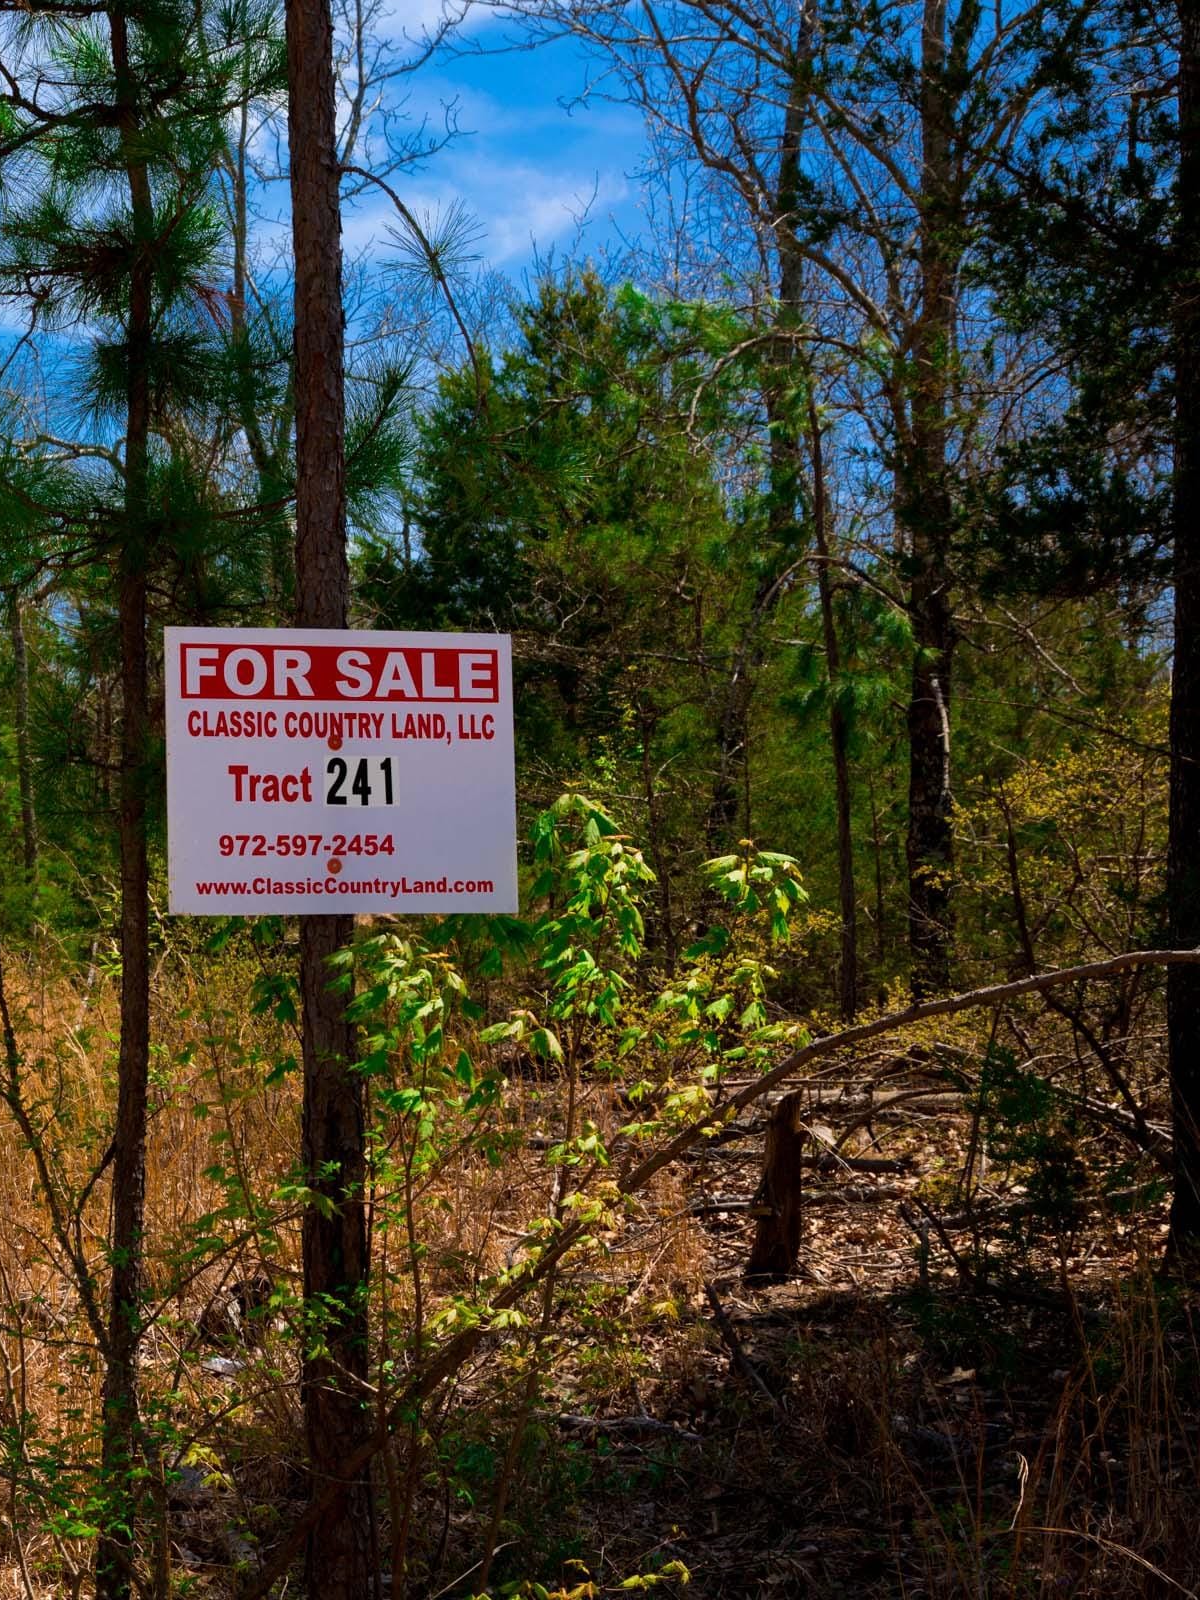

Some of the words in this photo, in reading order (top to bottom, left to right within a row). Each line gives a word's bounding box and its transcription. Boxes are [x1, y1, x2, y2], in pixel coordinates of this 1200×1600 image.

[185, 648, 315, 697] FOR
[336, 650, 494, 699] SALE
[188, 711, 277, 737] CLASSIC
[285, 712, 385, 739] COUNTRY
[392, 713, 451, 745] LAND,
[459, 714, 495, 739] LLC
[228, 765, 312, 802] Tract
[326, 757, 393, 805] 241
[219, 835, 395, 856] 972-597-2454
[197, 877, 493, 897] www.ClassicCountryLand.com
